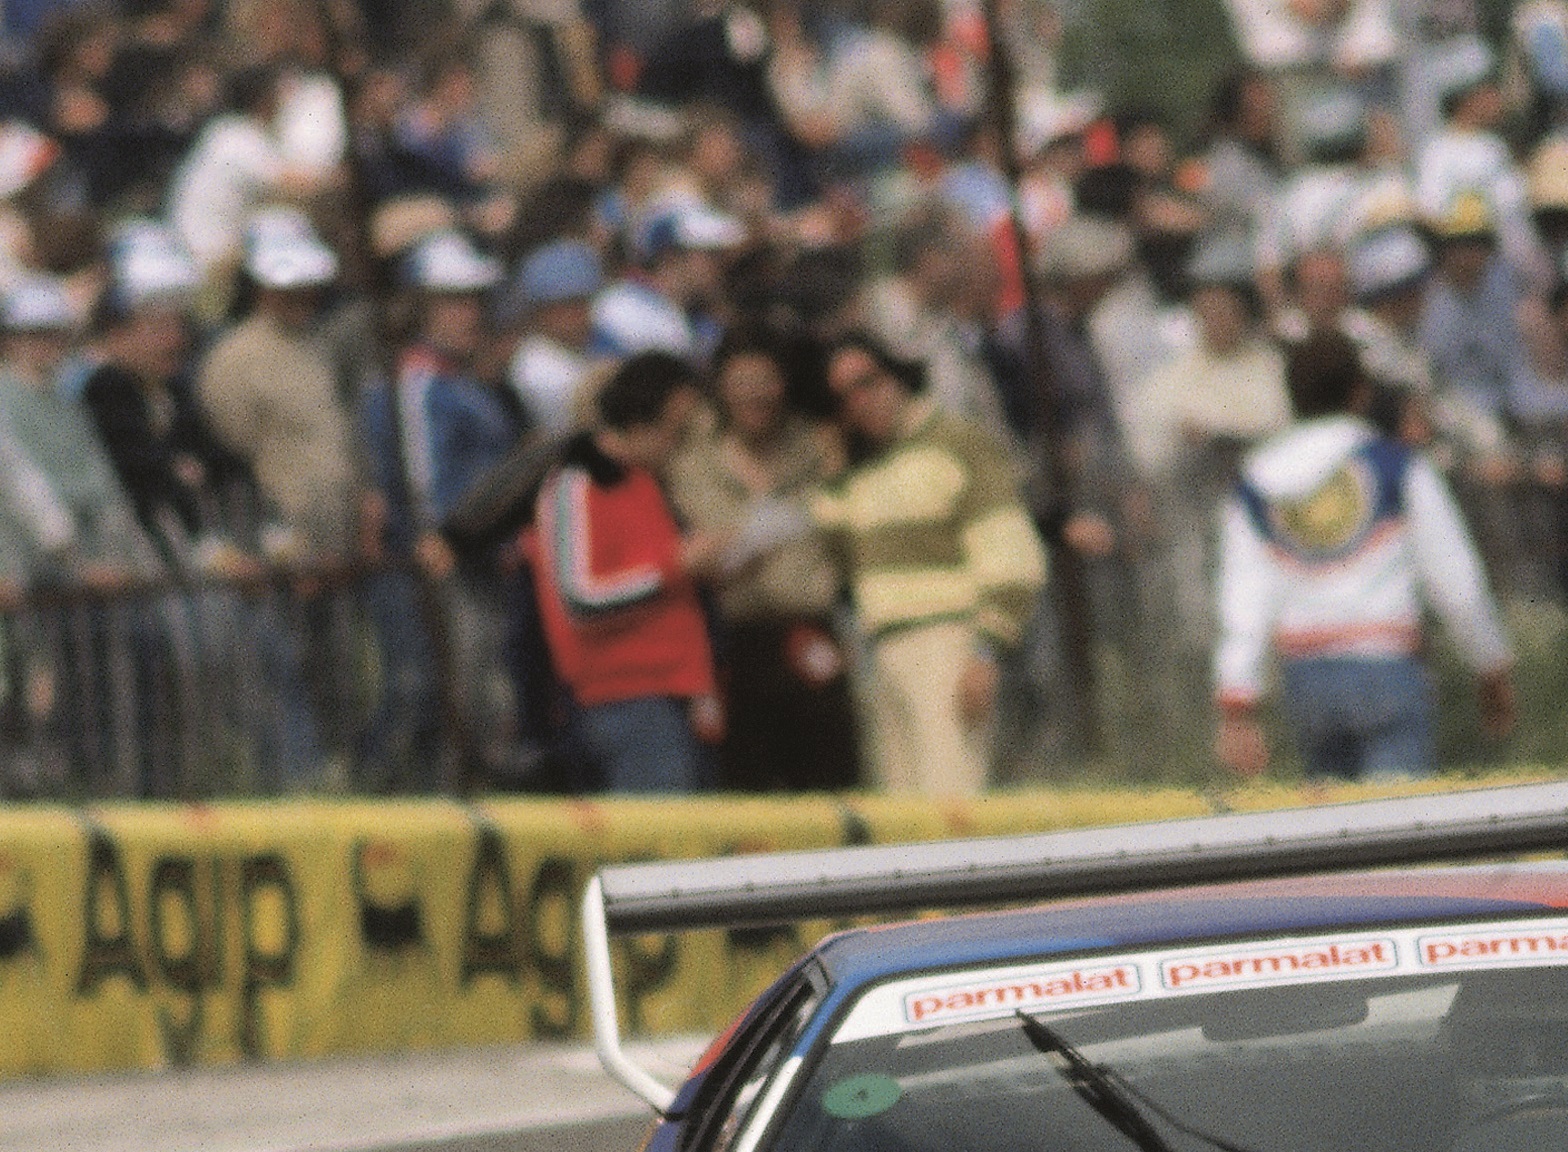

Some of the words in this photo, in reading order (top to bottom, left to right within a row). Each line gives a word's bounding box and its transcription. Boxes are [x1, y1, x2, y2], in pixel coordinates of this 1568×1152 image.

[75, 828, 299, 1066] Agip
[459, 822, 679, 1038] Agp
[913, 968, 1130, 1020] parmalat
[1170, 943, 1385, 986] parmalat
